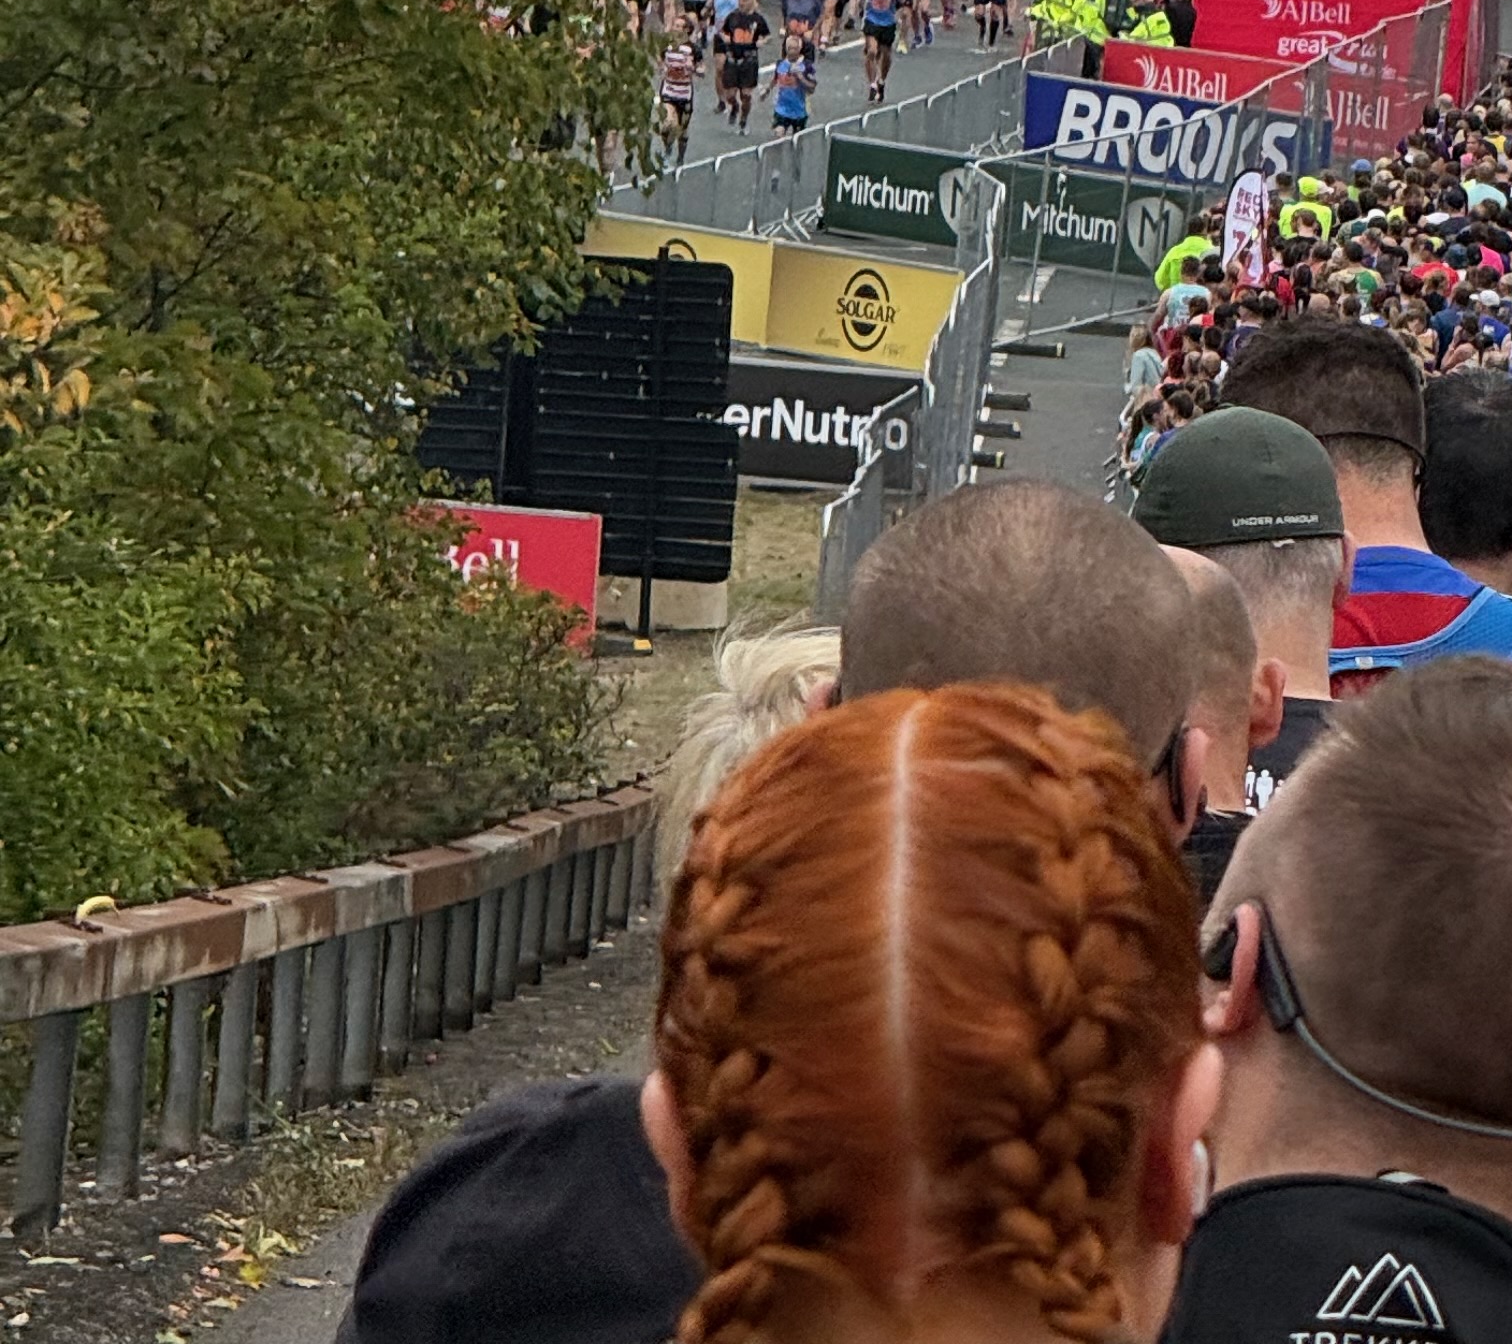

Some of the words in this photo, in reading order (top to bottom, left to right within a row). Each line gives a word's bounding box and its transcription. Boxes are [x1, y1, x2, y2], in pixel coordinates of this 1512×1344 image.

[1280, 0, 1350, 25] AJBell
[1277, 35, 1328, 56] great
[1053, 88, 1298, 192] BROOKS
[836, 173, 930, 215] Mitchum
[1021, 200, 1117, 245] Mitchum
[836, 297, 897, 324] SOLGAR
[1231, 516, 1273, 527] UNDER
[1275, 514, 1319, 525] ARMOUR
